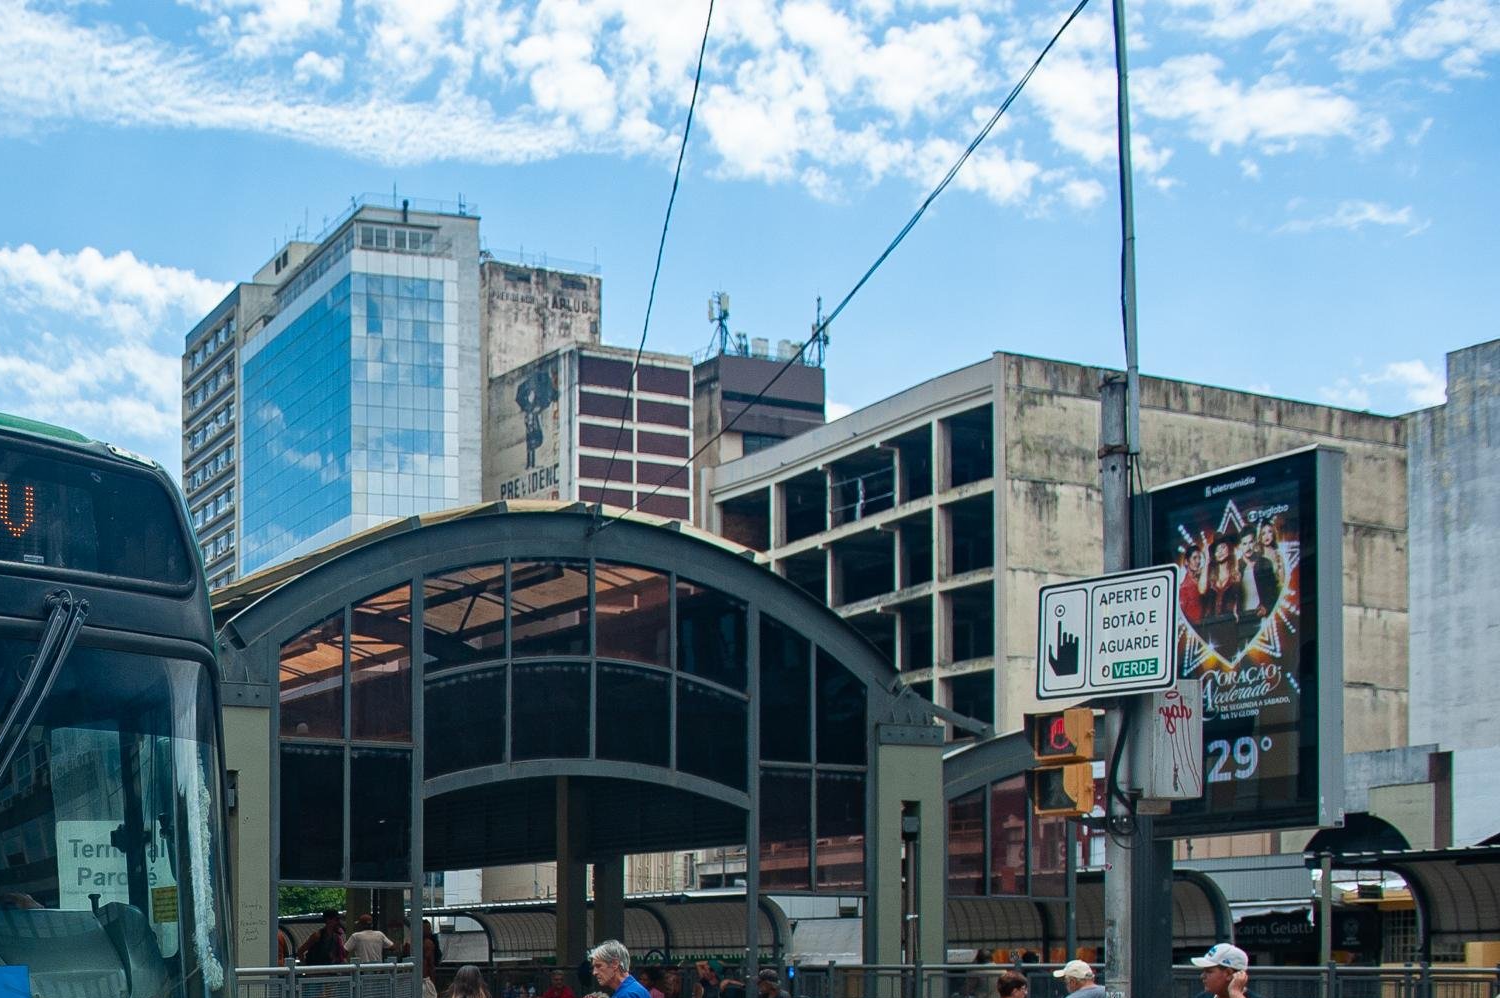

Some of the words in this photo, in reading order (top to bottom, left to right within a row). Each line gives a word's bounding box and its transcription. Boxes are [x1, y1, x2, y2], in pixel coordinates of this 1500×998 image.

[1099, 587, 1148, 606] APERTE
[1151, 585, 1161, 599] O
[1102, 610, 1145, 630] BOTÃO
[1149, 610, 1157, 624] E
[1099, 634, 1159, 654] AGUARDE
[1101, 665, 1110, 678] O
[1113, 659, 1156, 677] VERDE
[69, 839, 165, 859] Termal
[77, 866, 158, 887] Paroé
[1235, 923, 1267, 936] caria
